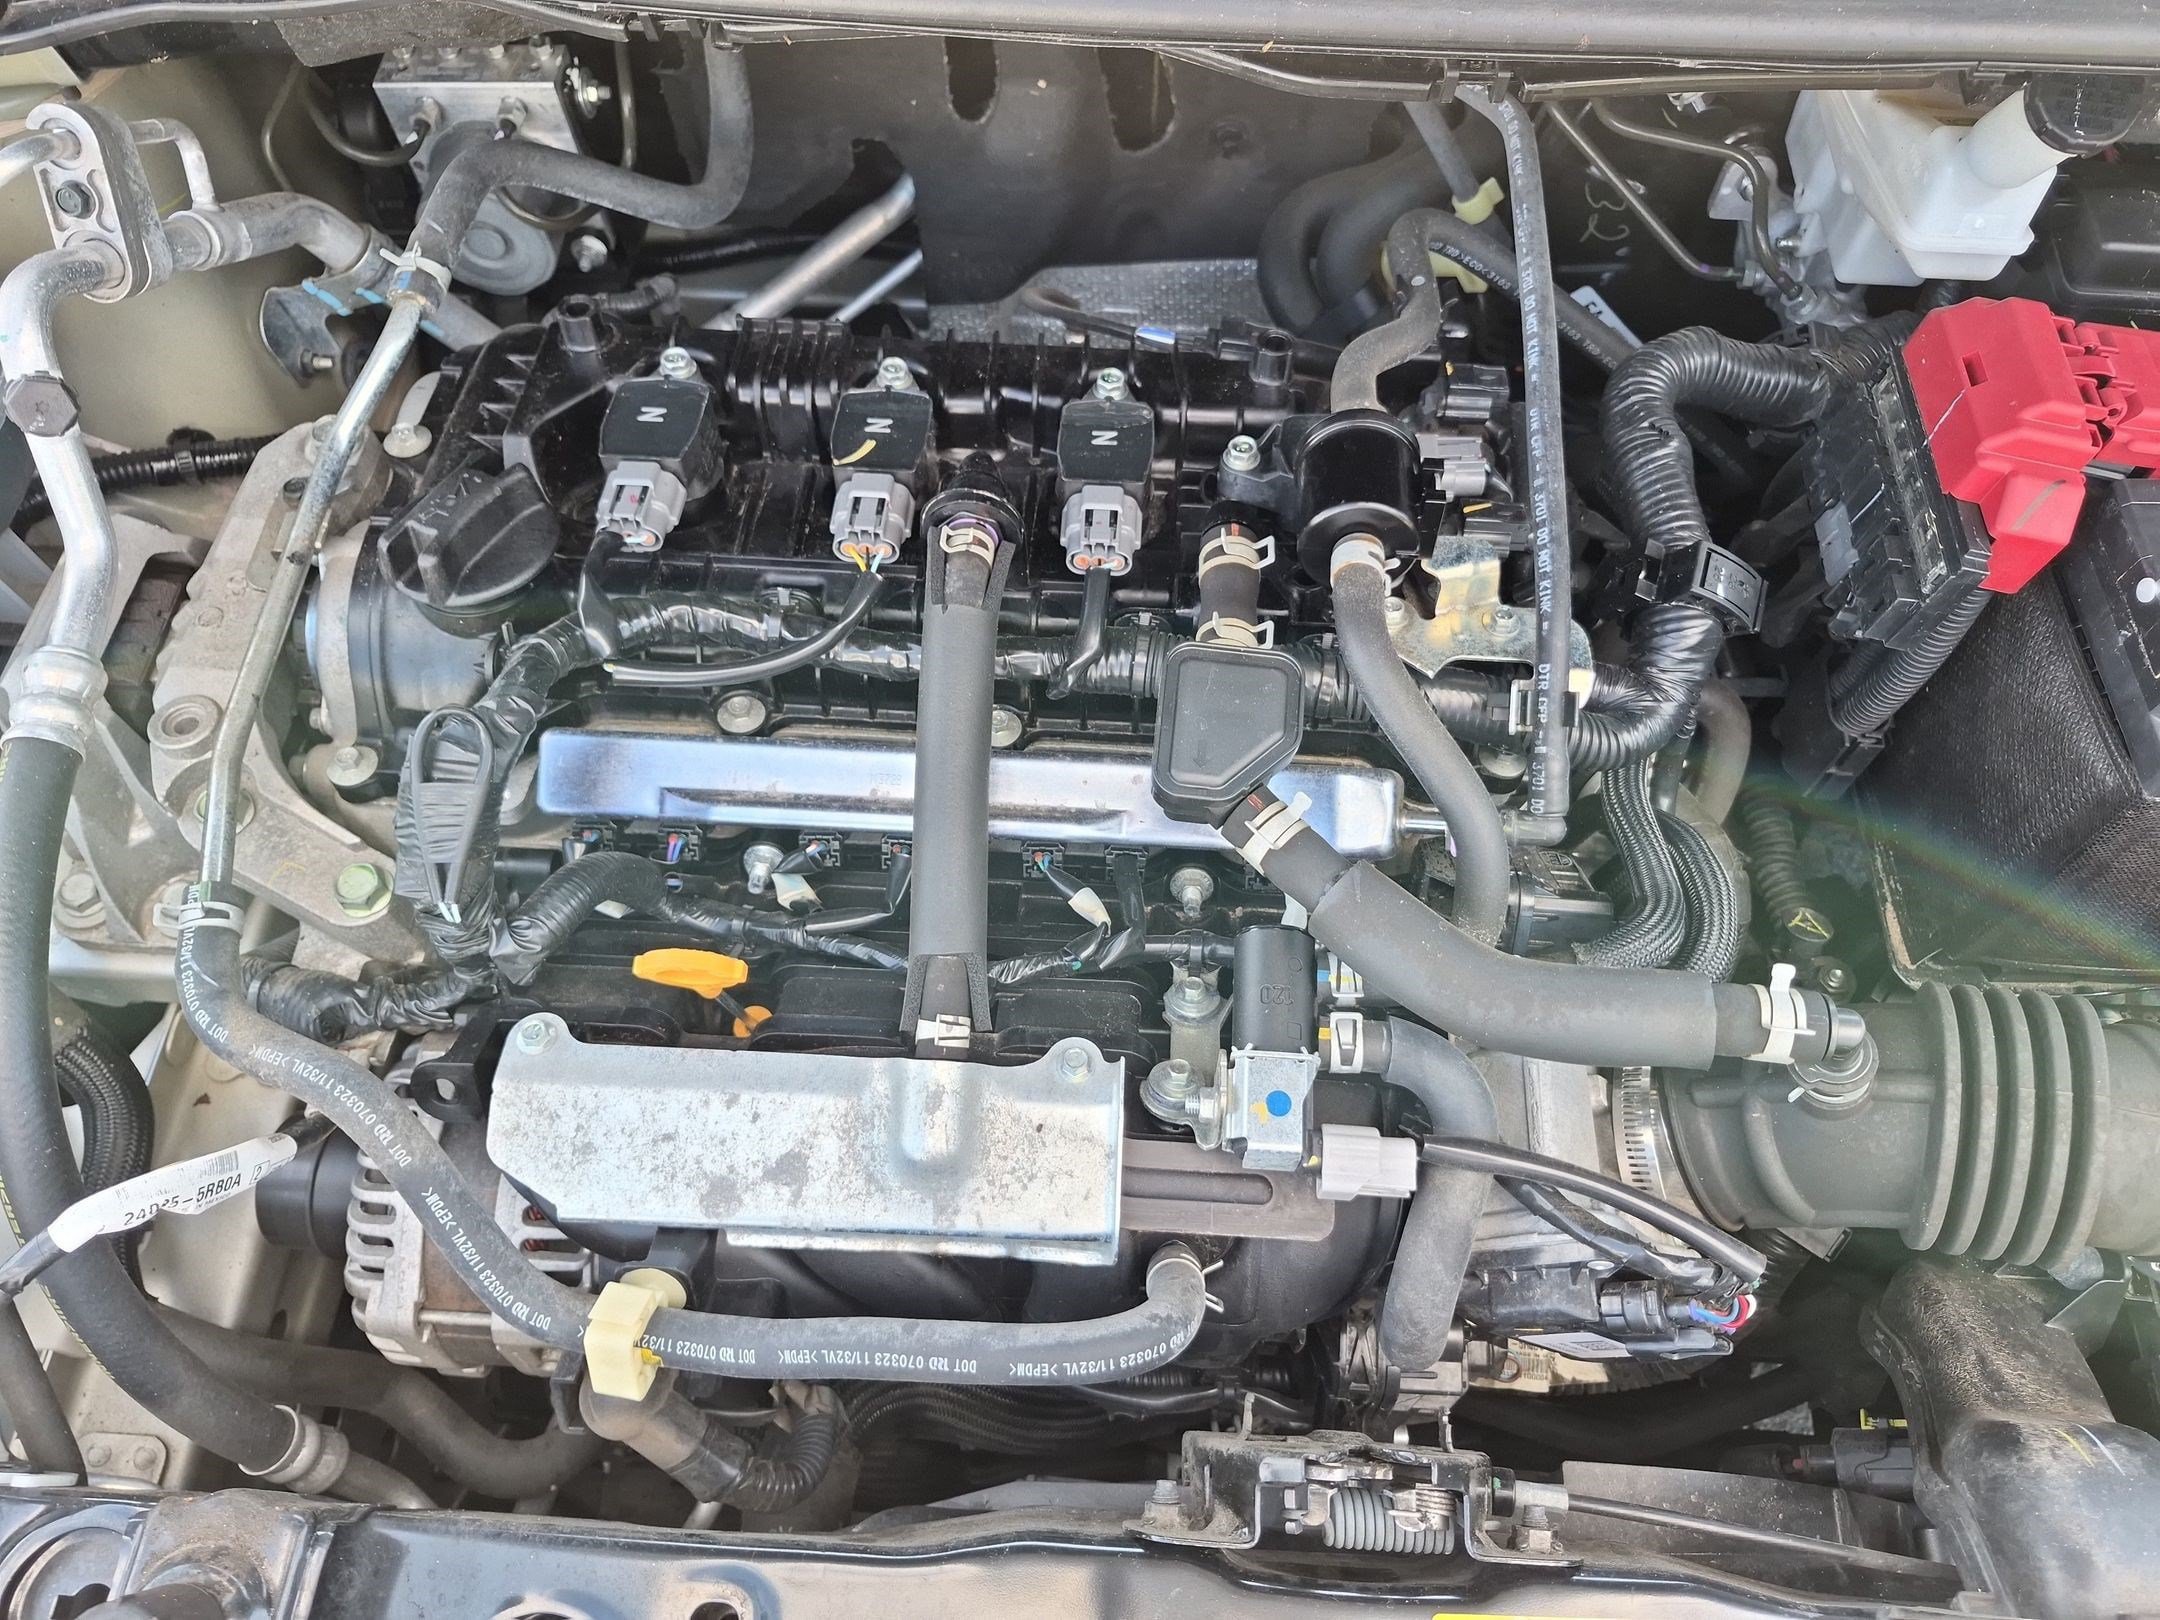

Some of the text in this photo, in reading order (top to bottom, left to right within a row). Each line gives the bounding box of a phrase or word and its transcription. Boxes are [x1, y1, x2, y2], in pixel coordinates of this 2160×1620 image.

[1538, 548, 1552, 573] NOT
[1539, 579, 1552, 614] KINK
[1531, 762, 1545, 791] 3701
[1530, 798, 1545, 815] DO
[181, 970, 199, 1012] 070323
[208, 1022, 229, 1044] DOT
[333, 1084, 377, 1125] 070323
[388, 1144, 412, 1168] DOT
[478, 1269, 513, 1307] 070323
[528, 1311, 552, 1331] DOT
[676, 1340, 717, 1361] 070323
[738, 1349, 756, 1364] DOT
[874, 1352, 924, 1369] 070323
[1119, 1342, 1168, 1369] 070323
[953, 1358, 977, 1374] DOT
